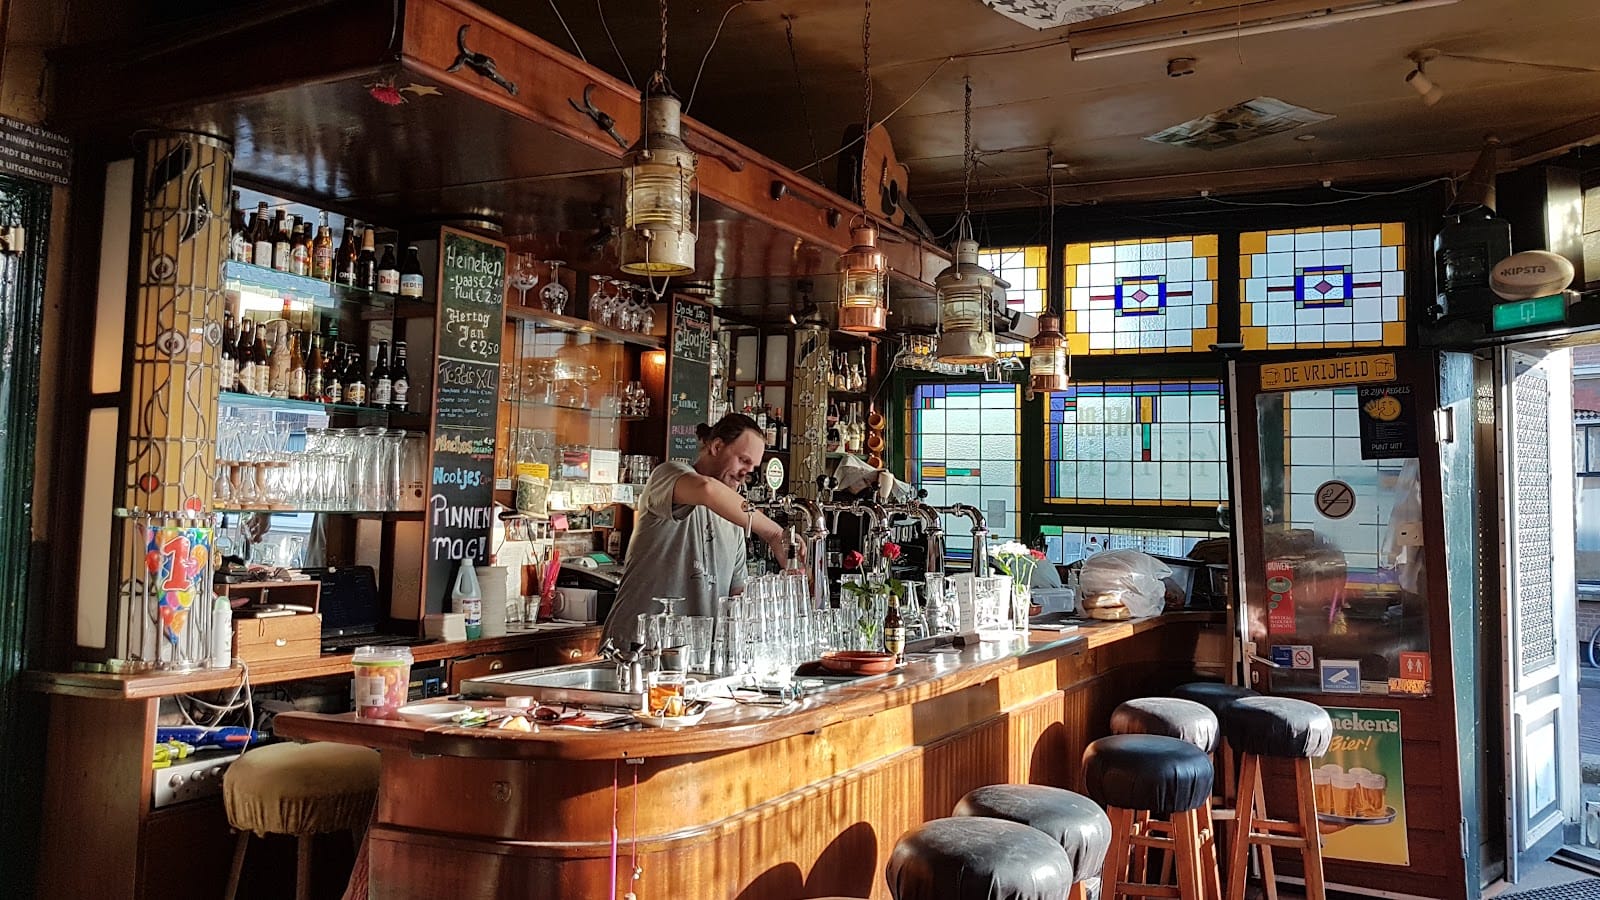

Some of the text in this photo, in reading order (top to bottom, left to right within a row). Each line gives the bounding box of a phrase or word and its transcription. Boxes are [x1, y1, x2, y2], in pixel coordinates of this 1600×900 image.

[6, 119, 24, 130] NIET
[25, 126, 40, 135] ALS
[5, 133, 35, 148] BINNEN
[21, 152, 30, 160] ER
[32, 155, 63, 169] METEEN
[446, 245, 502, 277] Heineken
[446, 307, 490, 333] Hertog
[458, 325, 484, 347] Jan
[476, 368, 496, 391] XL
[1284, 361, 1369, 383] DE VRIJHEID
[1361, 389, 1370, 397] ER
[1371, 443, 1388, 451] PUNT
[432, 466, 481, 490] Nootjes
[430, 493, 491, 529] PINNEN
